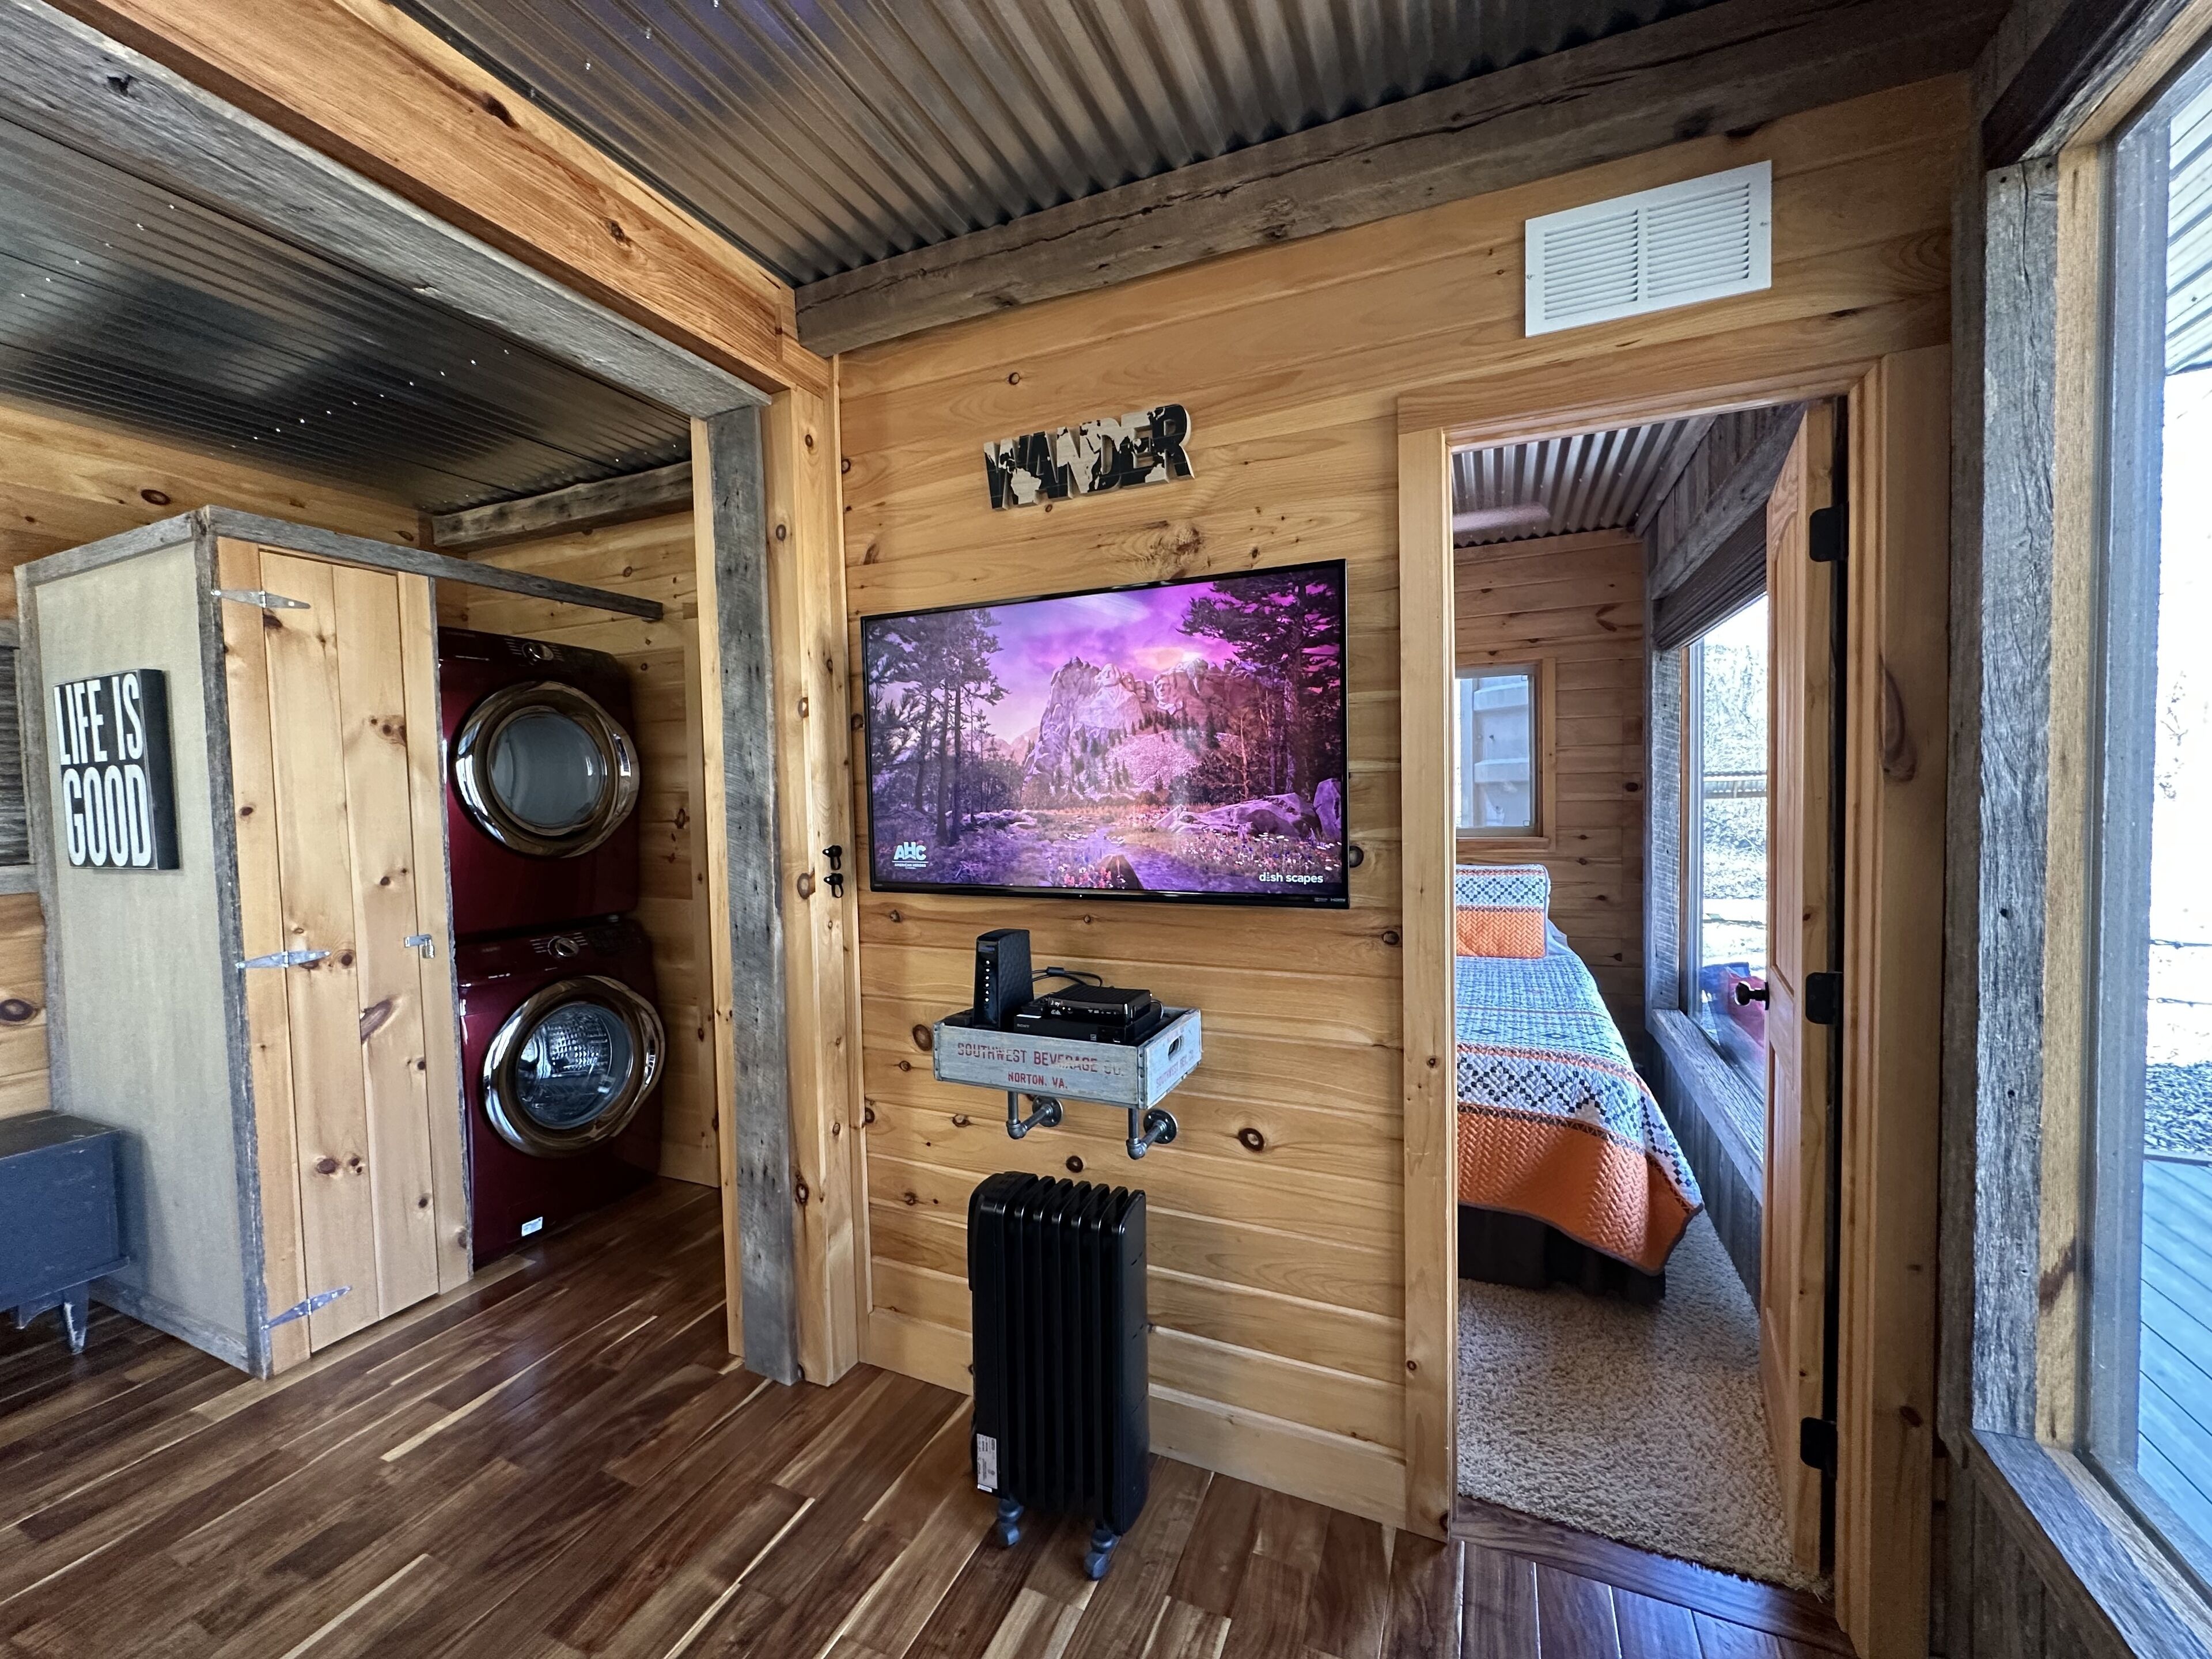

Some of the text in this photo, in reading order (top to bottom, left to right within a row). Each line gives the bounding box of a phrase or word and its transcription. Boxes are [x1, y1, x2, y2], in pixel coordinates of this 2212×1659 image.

[984, 404, 1194, 510] WANDER
[54, 673, 143, 765] LIFE IS
[63, 764, 151, 867] GOOD
[893, 842, 926, 861] AHC
[1259, 872, 1323, 885] dish scapes
[957, 1043, 1027, 1063] SOUTHWEST
[1033, 1051, 1098, 1073] BEVERAGE
[1052, 1077, 1068, 1089] VA.
